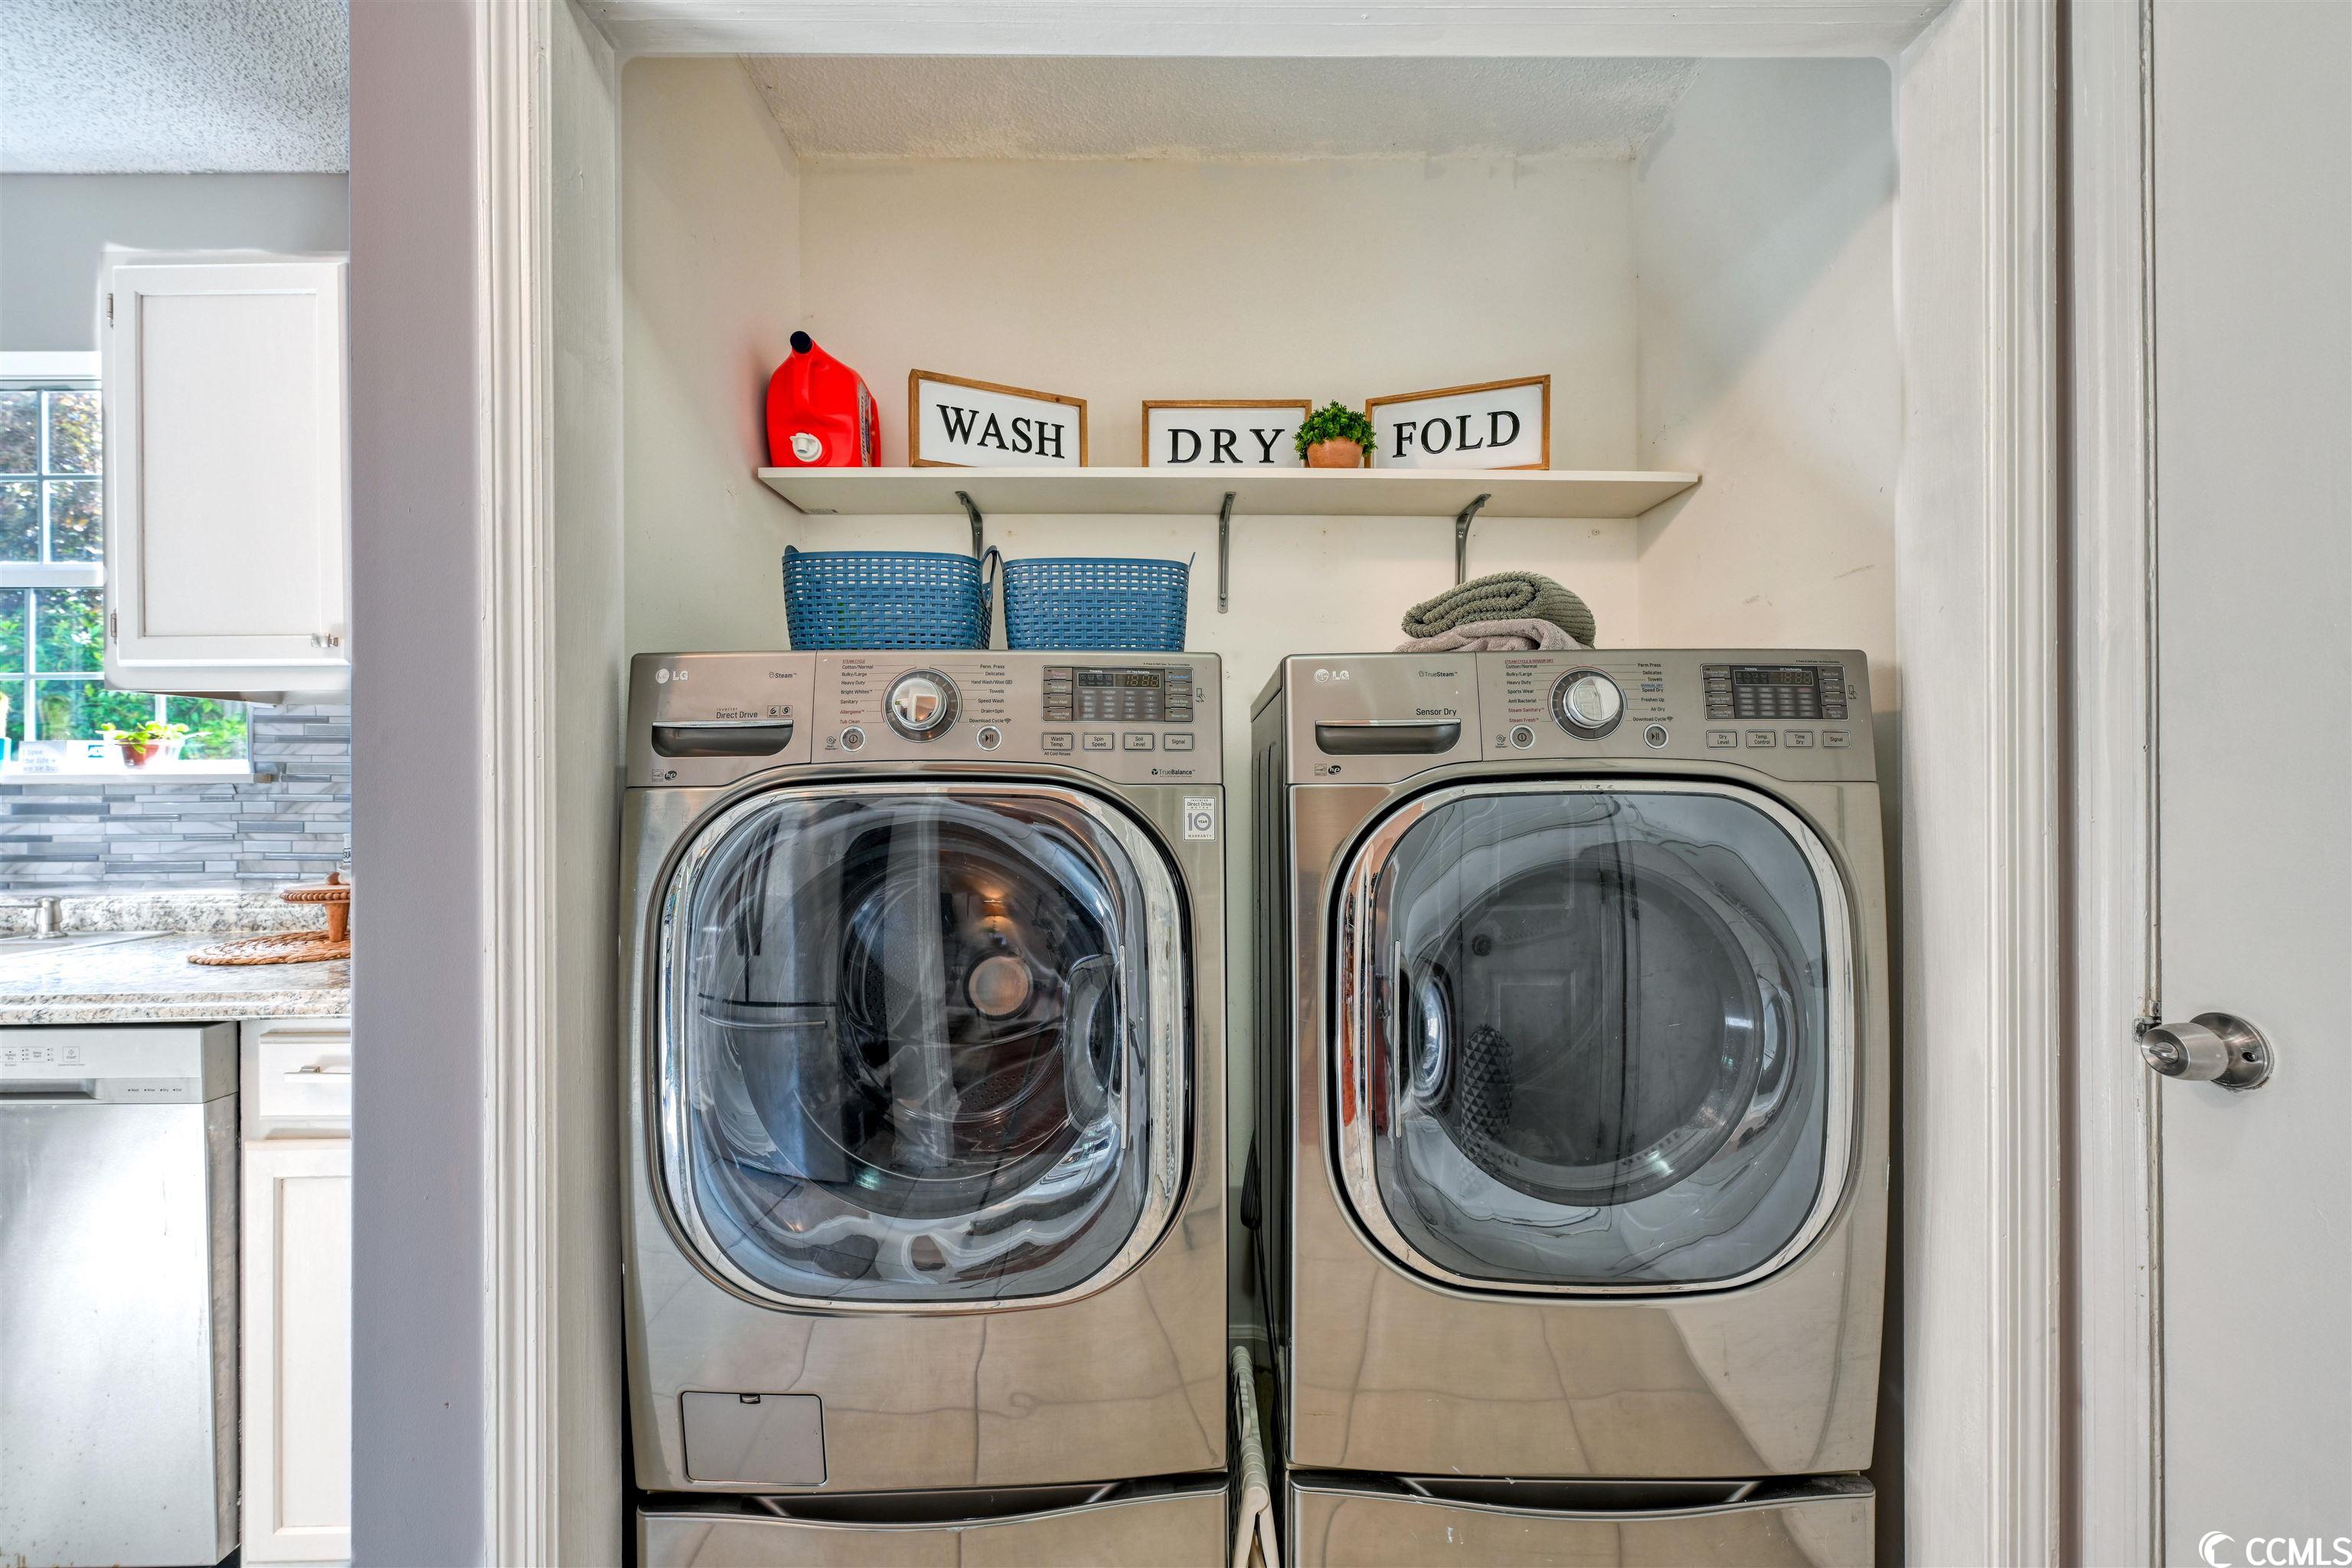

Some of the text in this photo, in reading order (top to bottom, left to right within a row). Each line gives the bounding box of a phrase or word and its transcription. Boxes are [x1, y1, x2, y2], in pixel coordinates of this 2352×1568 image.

[936, 404, 1065, 459] WASH
[1393, 410, 1520, 458] FOLD
[1168, 429, 1285, 463] DRY
[672, 671, 688, 680] LG
[1332, 671, 1349, 680] LG
[1444, 708, 1456, 717] Dry
[1187, 812, 1212, 831] 10
